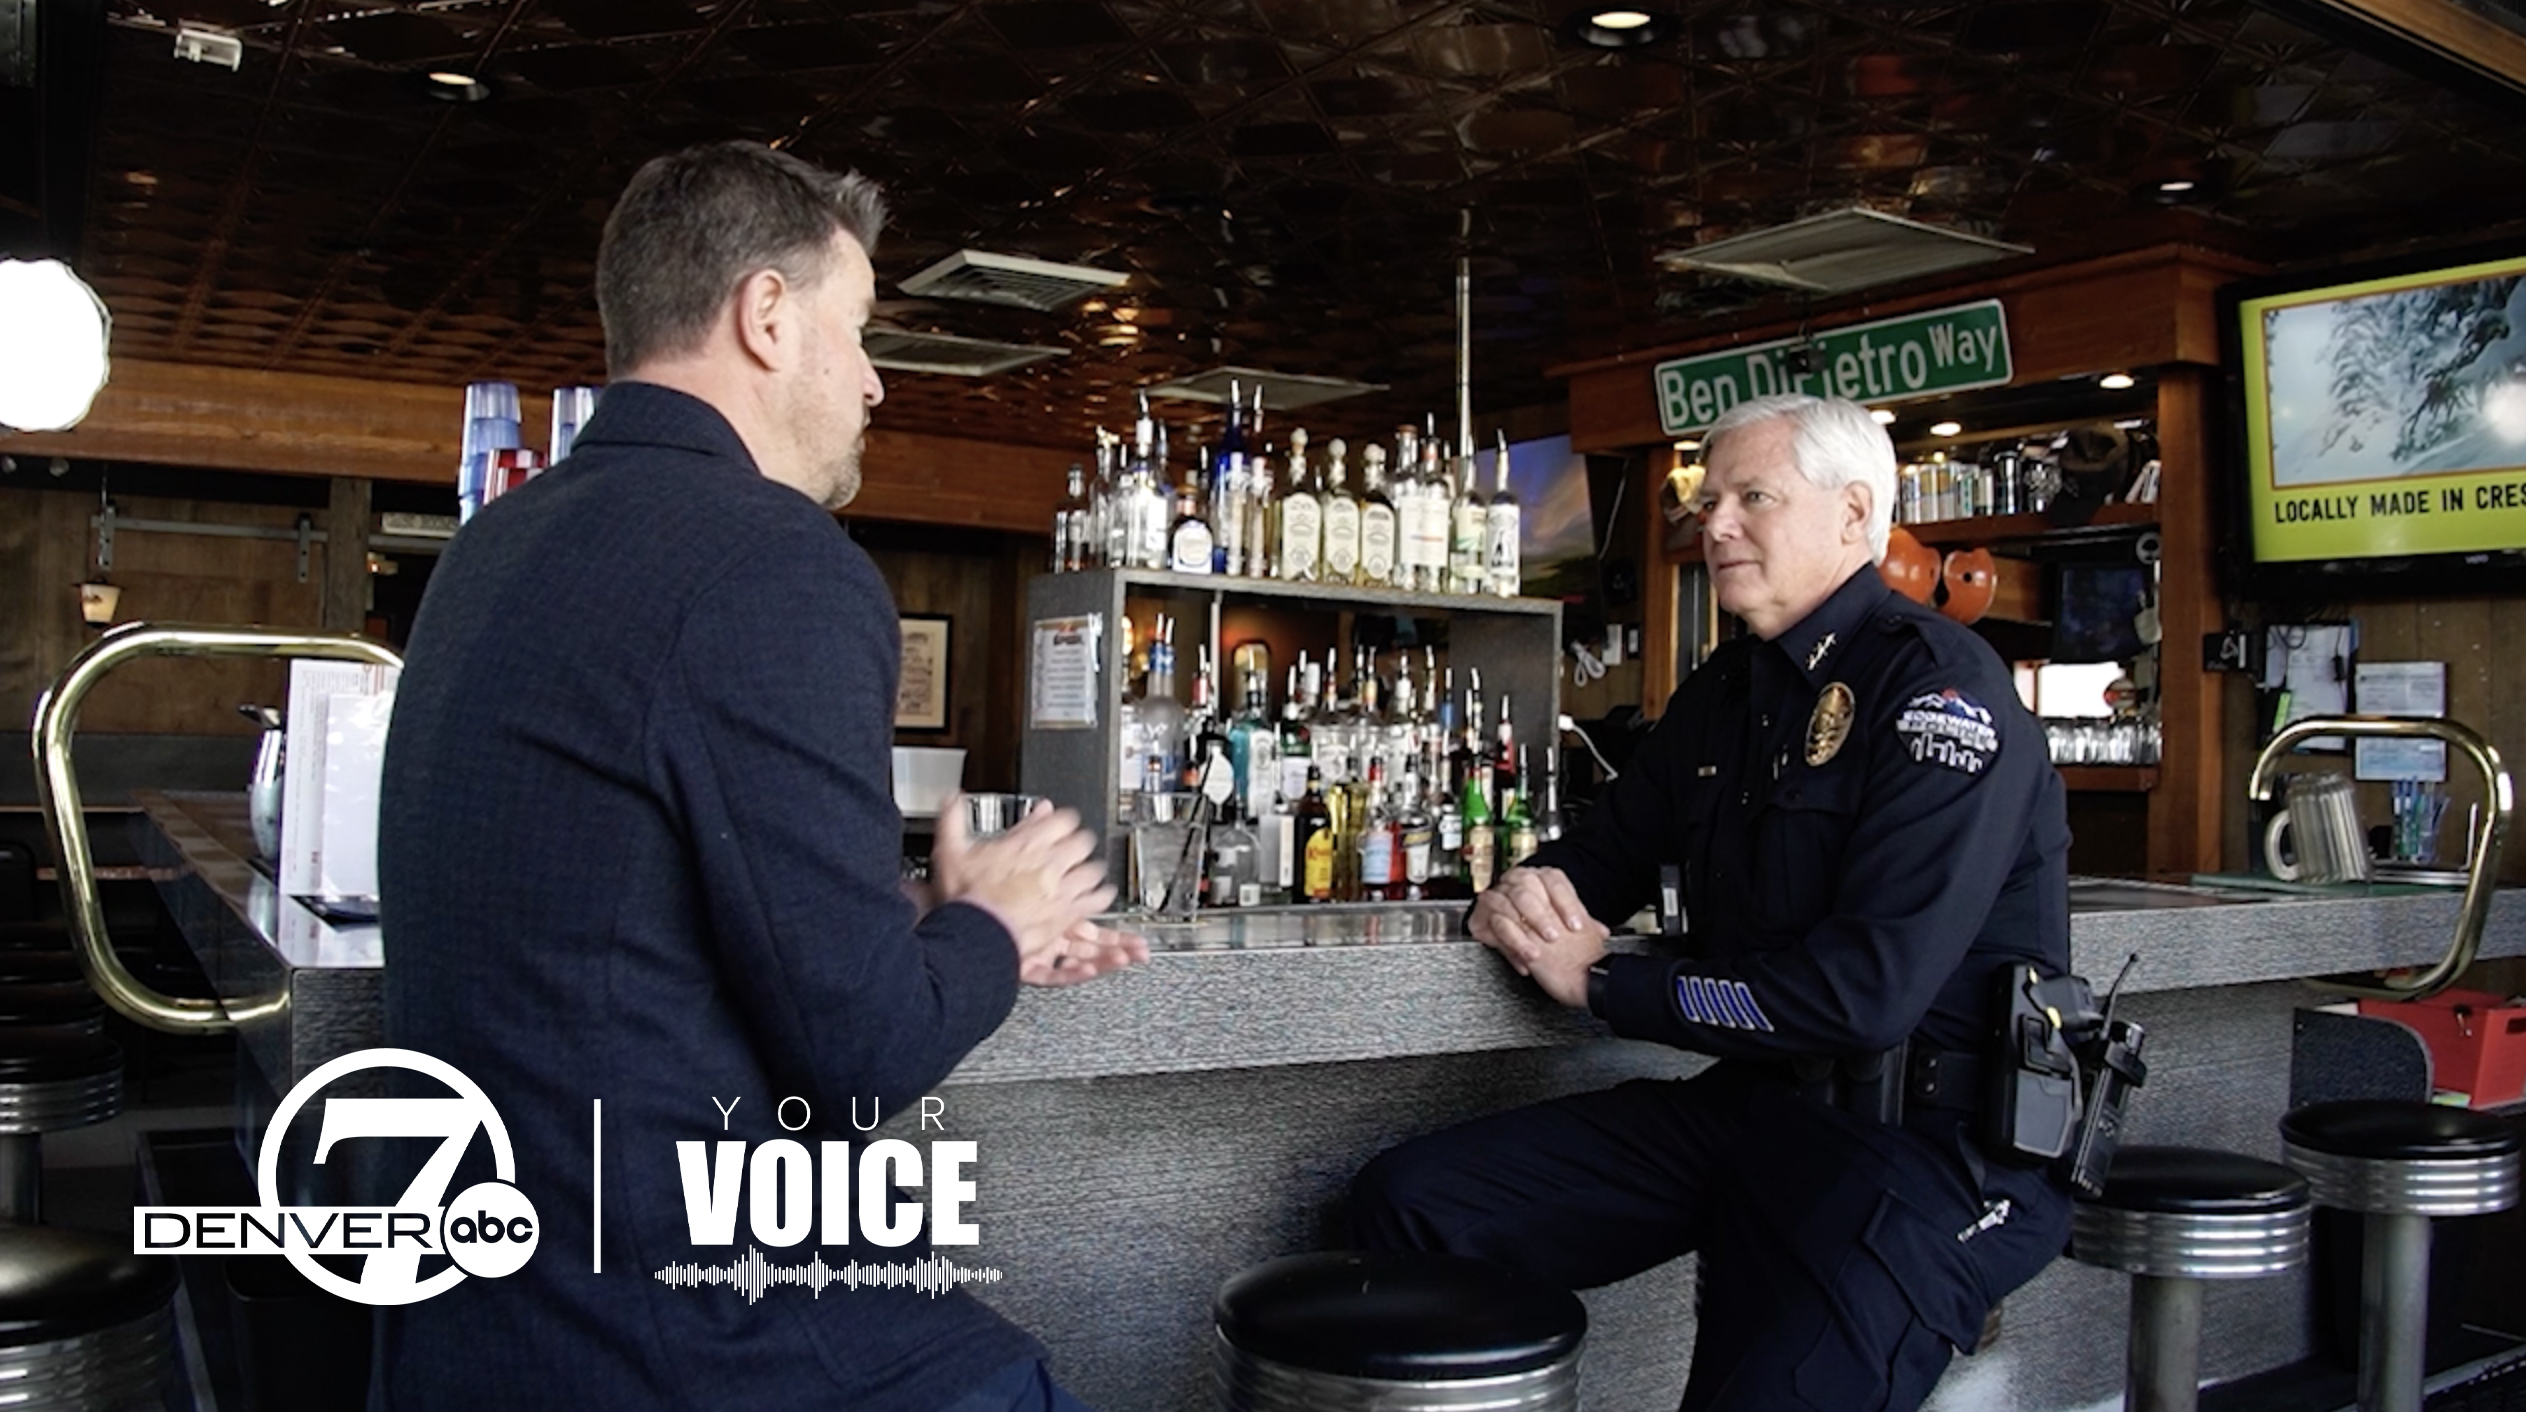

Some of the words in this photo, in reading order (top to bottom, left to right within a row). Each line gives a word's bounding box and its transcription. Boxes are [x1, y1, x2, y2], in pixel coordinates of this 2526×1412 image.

[1660, 370, 1739, 427] Ben
[1928, 322, 1998, 372] Way
[2274, 495, 2359, 524] LOCALLY
[2370, 490, 2430, 517] MADE
[2442, 488, 2464, 511] IN
